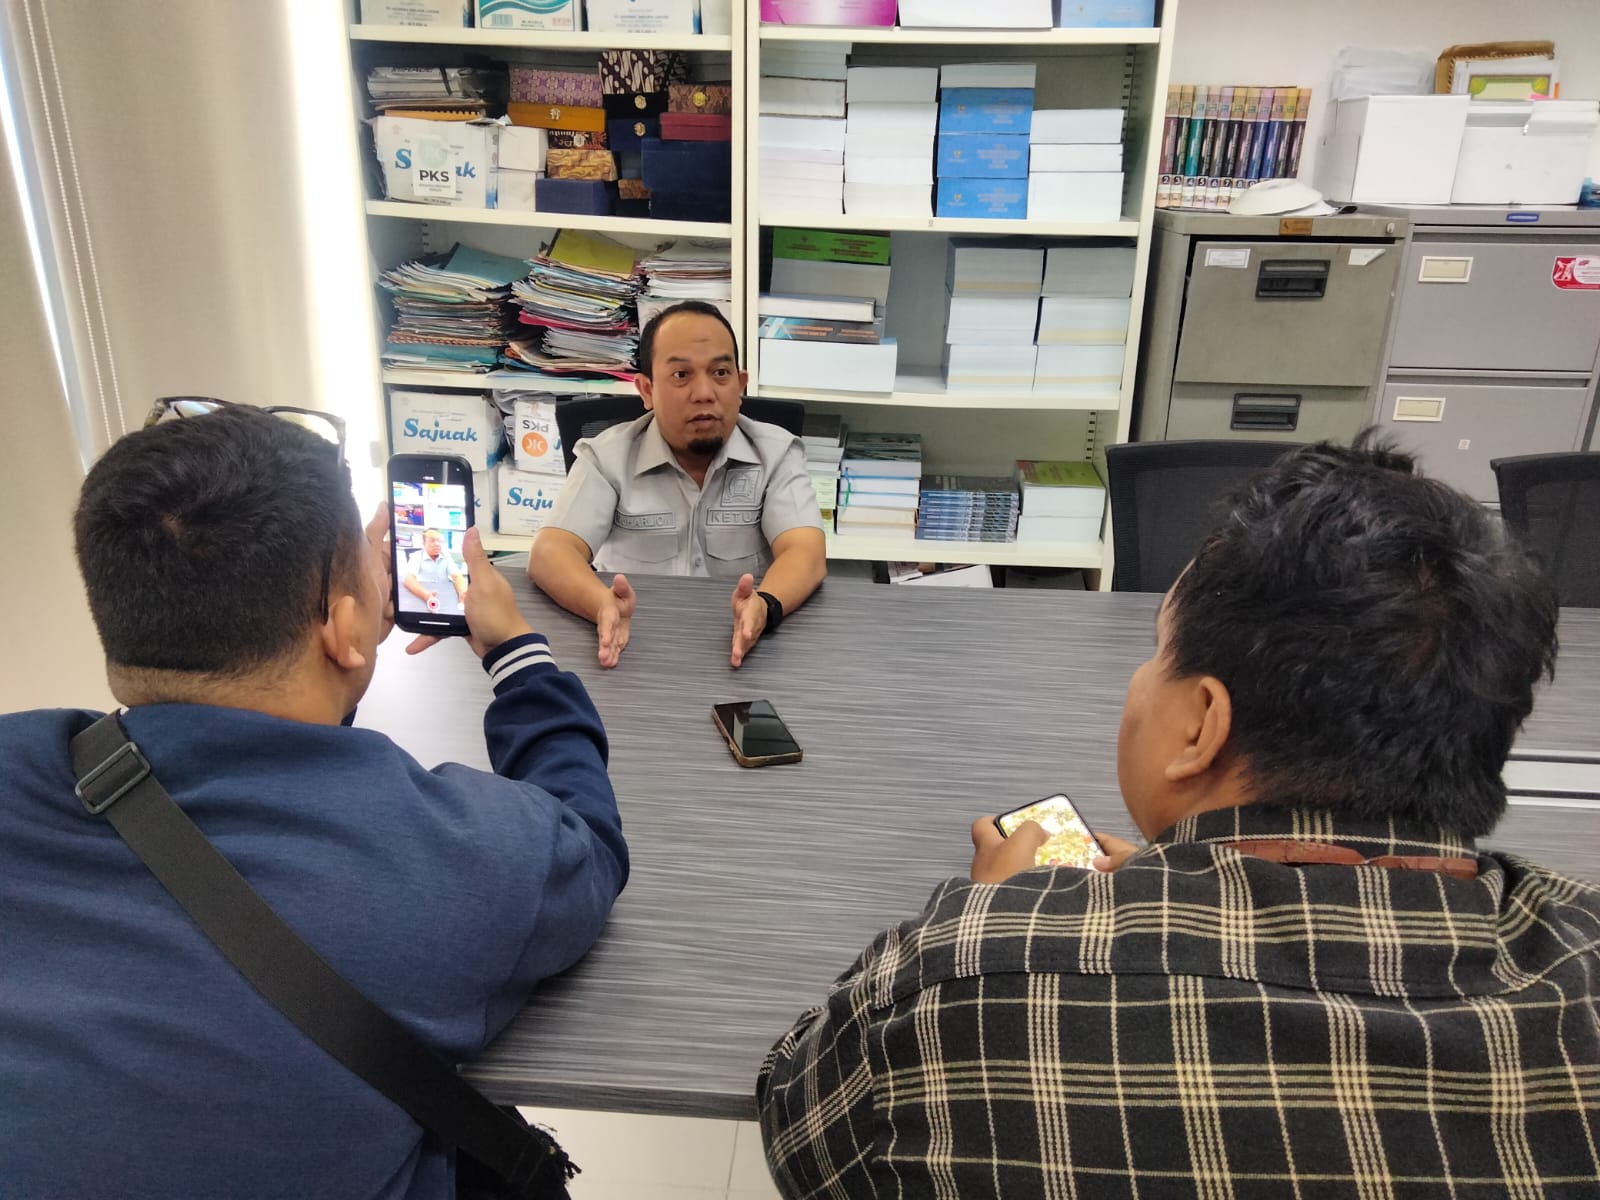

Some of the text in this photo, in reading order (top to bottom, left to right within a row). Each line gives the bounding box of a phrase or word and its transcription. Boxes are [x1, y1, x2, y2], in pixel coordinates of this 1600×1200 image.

[419, 169, 450, 183] PKS
[403, 416, 478, 442] Sajuak
[521, 419, 549, 433] PKS
[507, 486, 553, 511] Saju
